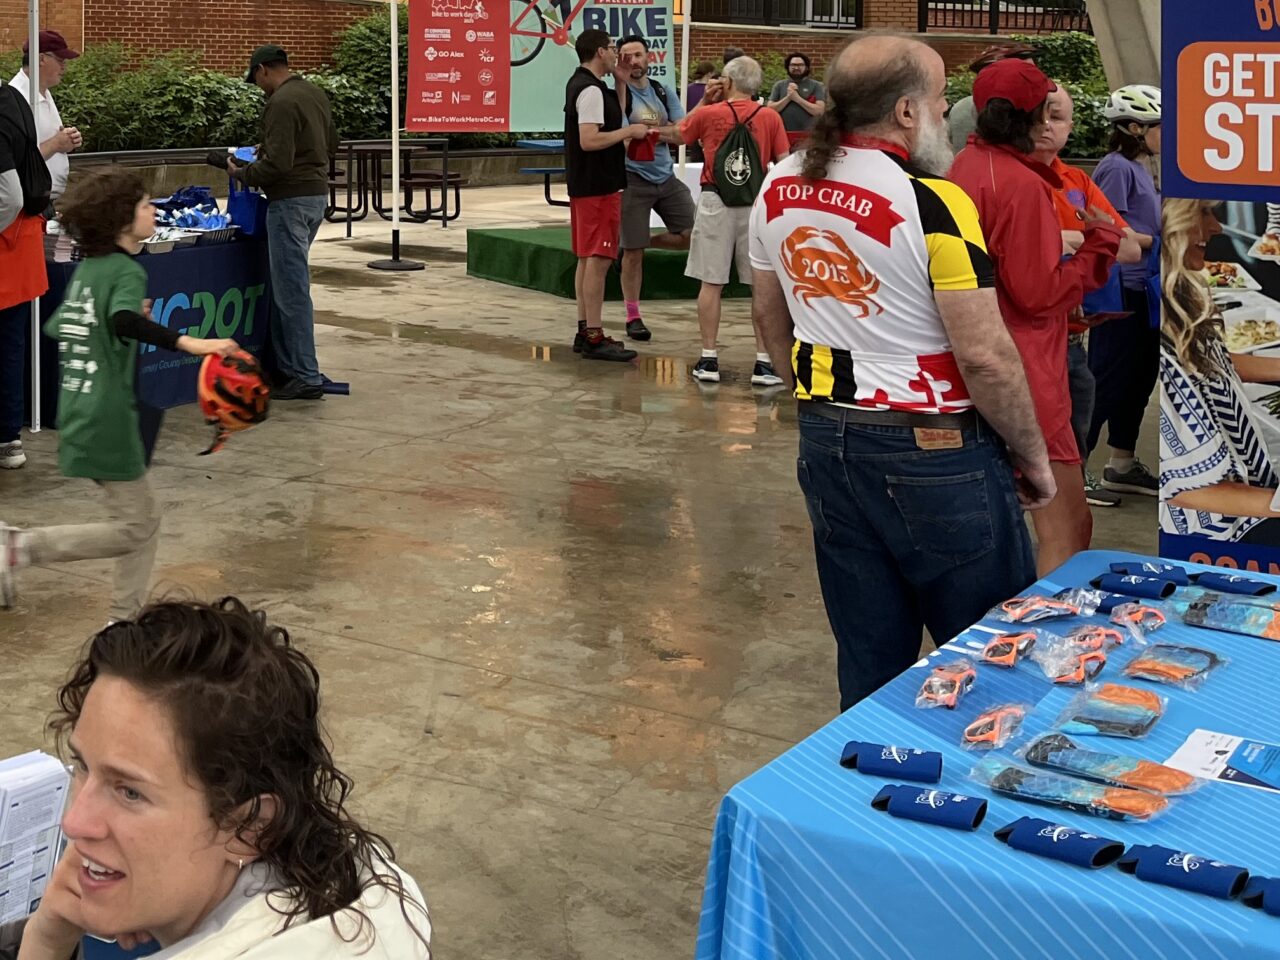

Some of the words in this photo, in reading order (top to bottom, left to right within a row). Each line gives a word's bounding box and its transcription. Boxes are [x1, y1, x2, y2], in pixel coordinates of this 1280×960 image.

[583, 7, 668, 38] BIKE
[1203, 52, 1280, 98] GET
[776, 184, 814, 201] TOP
[817, 187, 873, 217] CRAB
[801, 258, 851, 284] 2015
